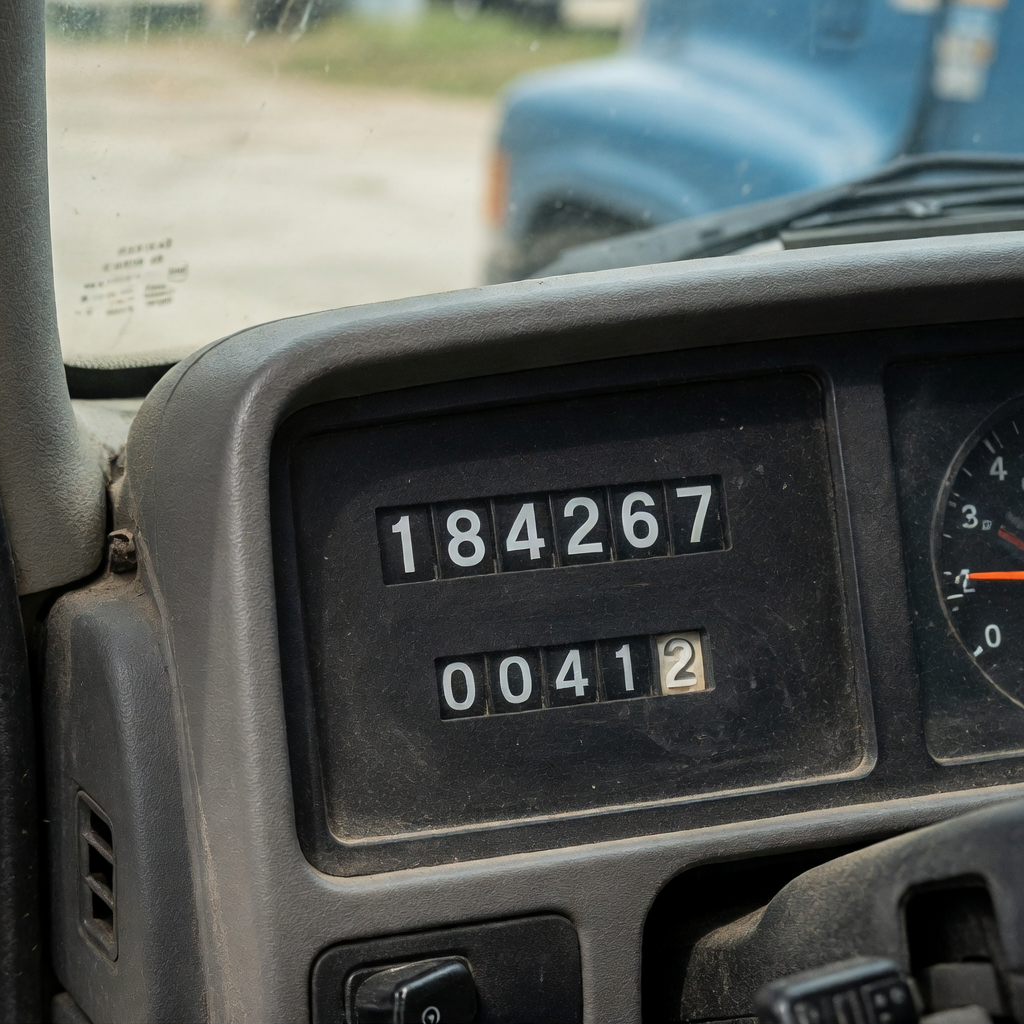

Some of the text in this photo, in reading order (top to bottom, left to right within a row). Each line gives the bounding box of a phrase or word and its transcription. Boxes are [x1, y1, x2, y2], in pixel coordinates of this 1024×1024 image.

[989, 456, 1008, 481] 4
[961, 504, 979, 529] 3
[390, 485, 713, 575] 184267
[984, 624, 1002, 648] 0
[442, 638, 698, 711] 00412
